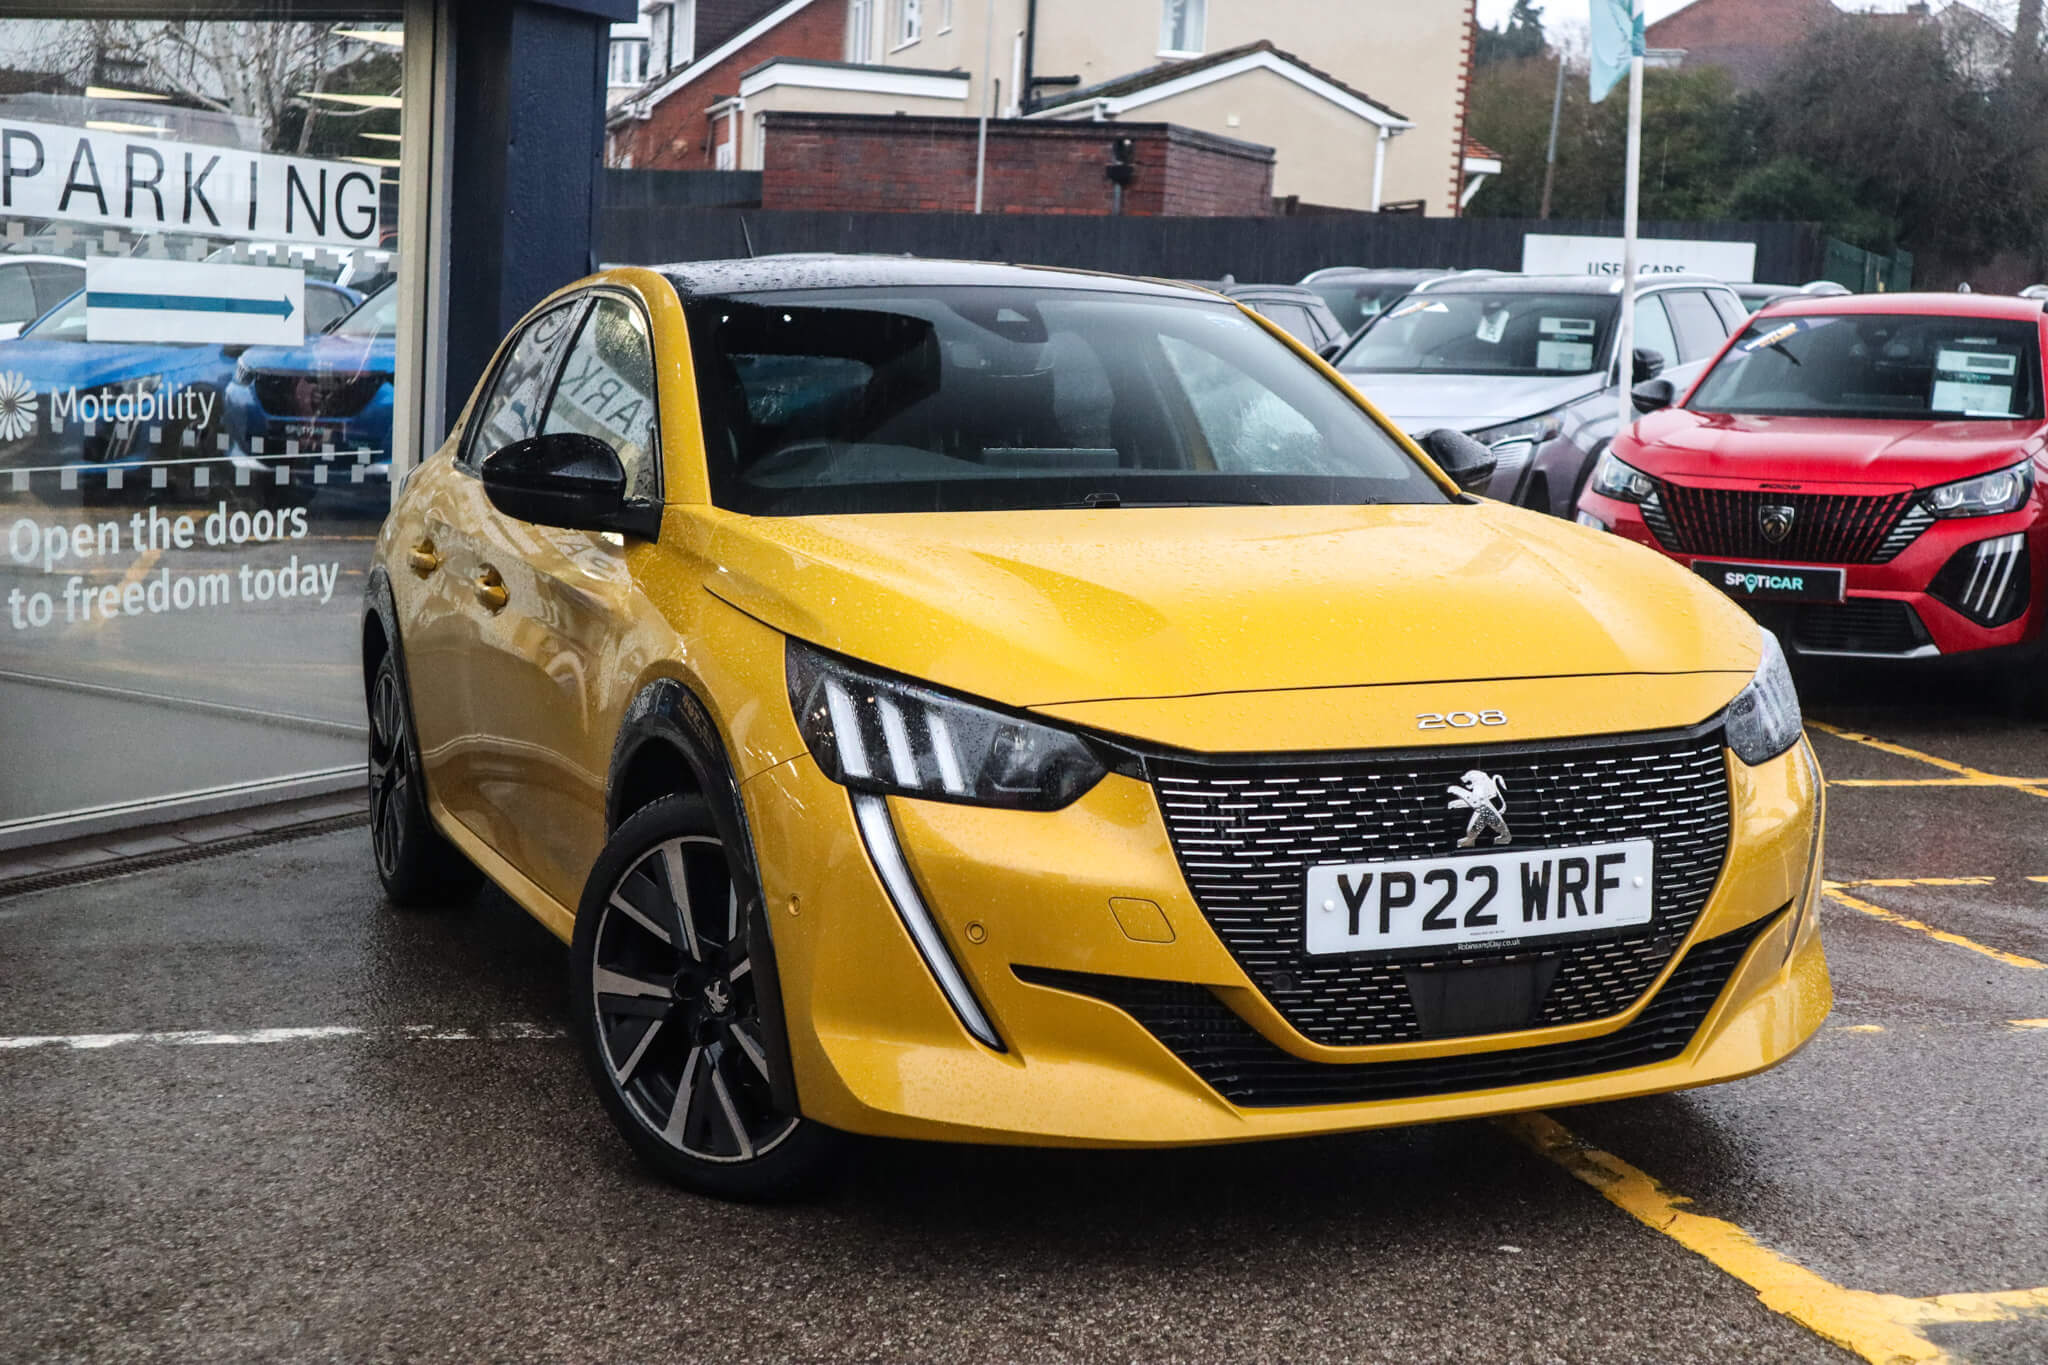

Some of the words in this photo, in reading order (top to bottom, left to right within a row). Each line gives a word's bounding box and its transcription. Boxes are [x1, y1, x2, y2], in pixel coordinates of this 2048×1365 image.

[1, 128, 377, 240] PARKING
[1587, 262, 1622, 275] USE
[50, 382, 216, 428] Motability
[8, 517, 119, 573] Open
[130, 505, 195, 552] the
[205, 501, 308, 546] doors
[9, 587, 53, 630] to
[63, 567, 230, 623] freedom
[239, 555, 340, 605] today
[1416, 709, 1508, 730] 208
[1337, 864, 1499, 936] YP22
[1520, 852, 1627, 923] WRF
